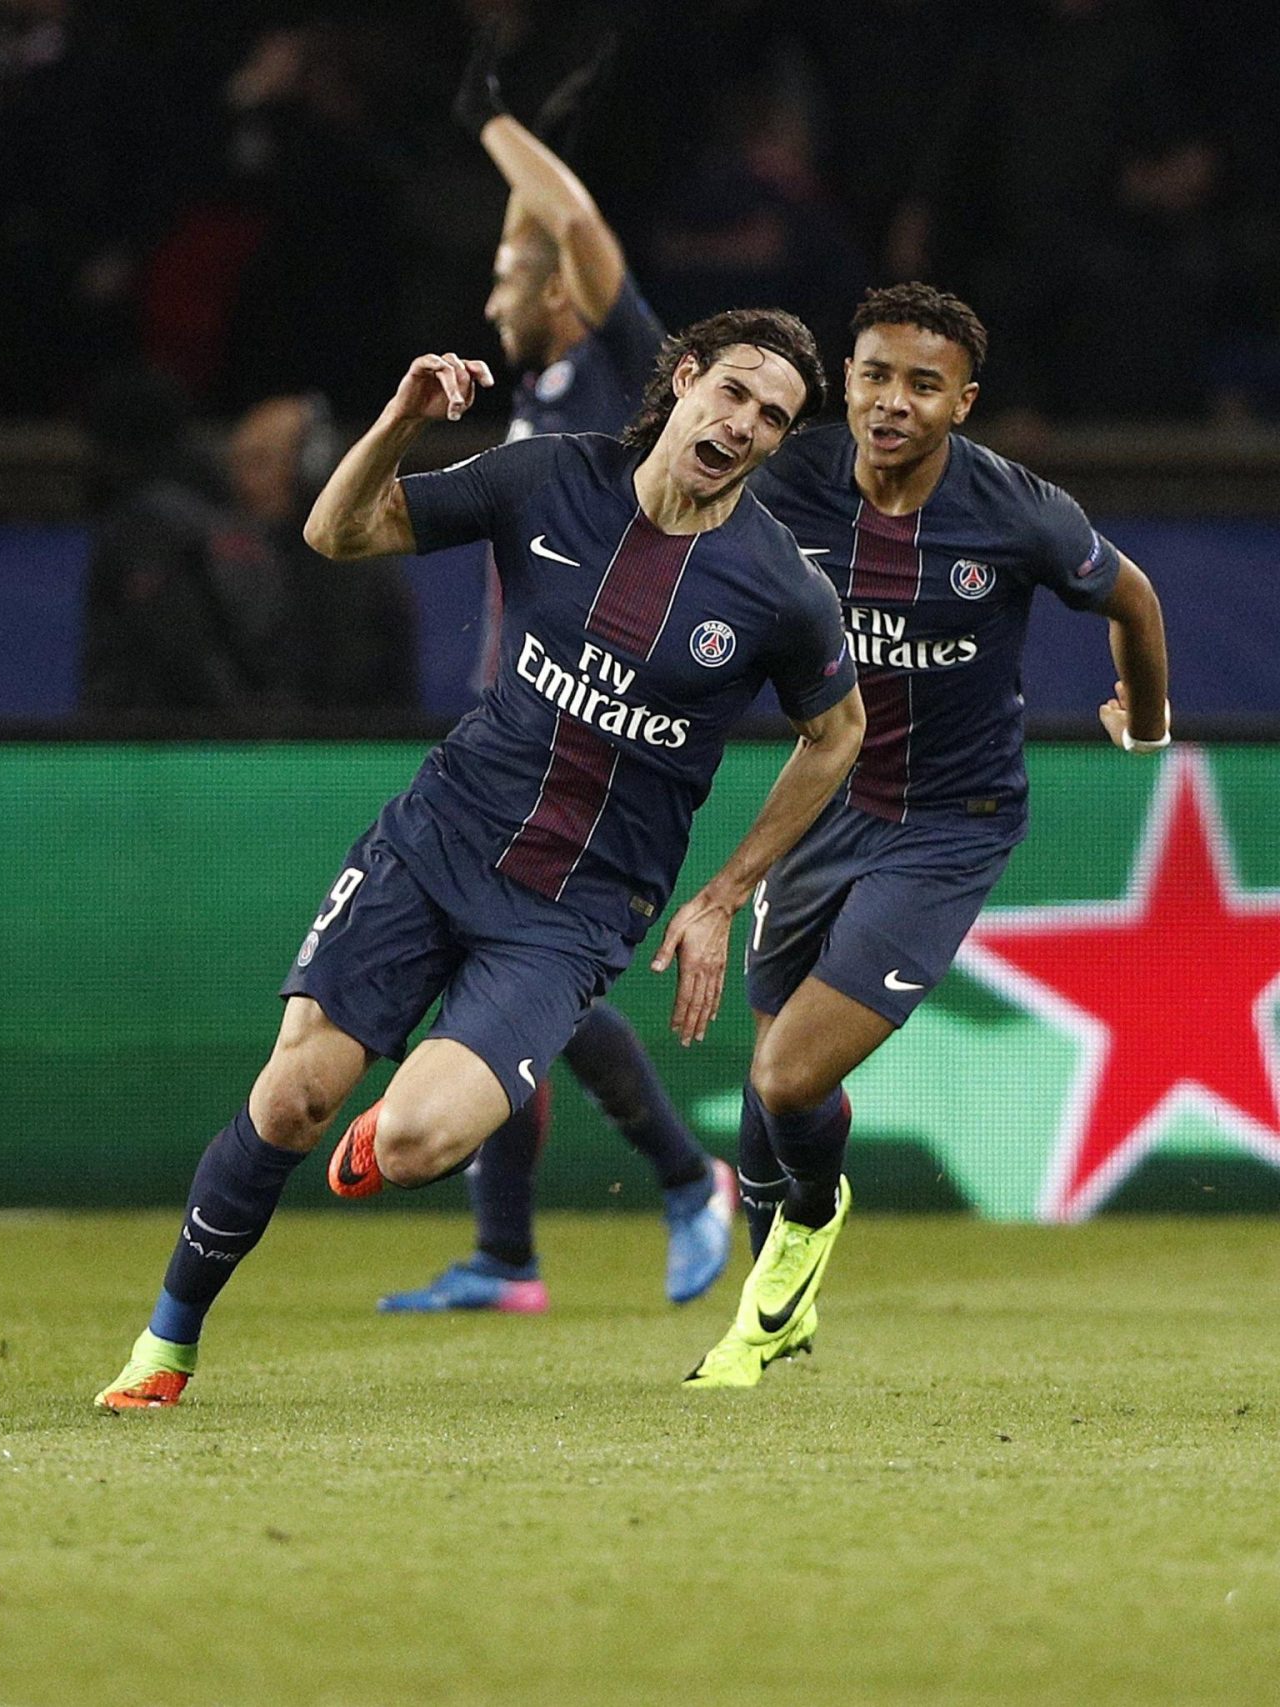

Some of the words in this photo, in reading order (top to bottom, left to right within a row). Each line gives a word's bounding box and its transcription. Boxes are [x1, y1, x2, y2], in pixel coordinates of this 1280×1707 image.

[844, 630, 979, 669] irates
[850, 606, 906, 644] Fly
[516, 631, 691, 749] Emirates
[578, 641, 636, 695] Fly
[312, 867, 365, 931] 9
